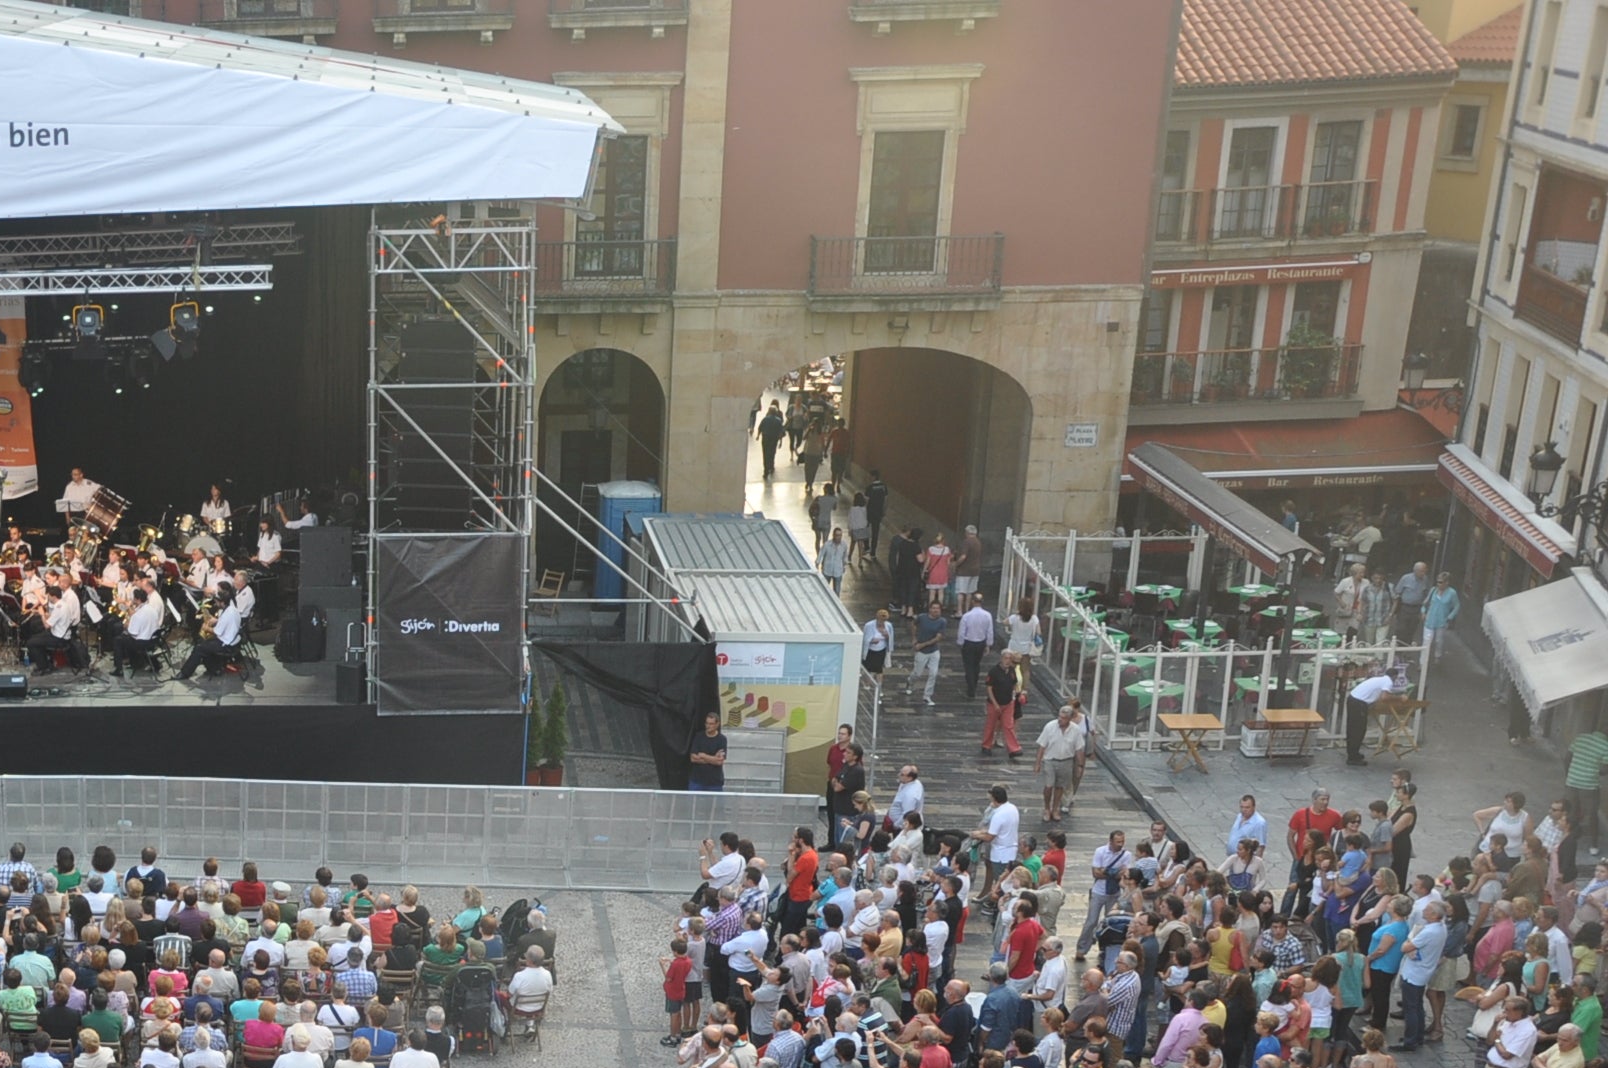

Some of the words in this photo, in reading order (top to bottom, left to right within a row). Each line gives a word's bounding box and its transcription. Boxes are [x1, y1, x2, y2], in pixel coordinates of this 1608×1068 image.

[9, 122, 69, 147] bien
[1152, 275, 1166, 285] ar
[1180, 271, 1255, 285] Entreplazas
[1267, 266, 1344, 280] Restaurante
[1267, 477, 1289, 488] Bar
[1312, 474, 1384, 486] Restaurante
